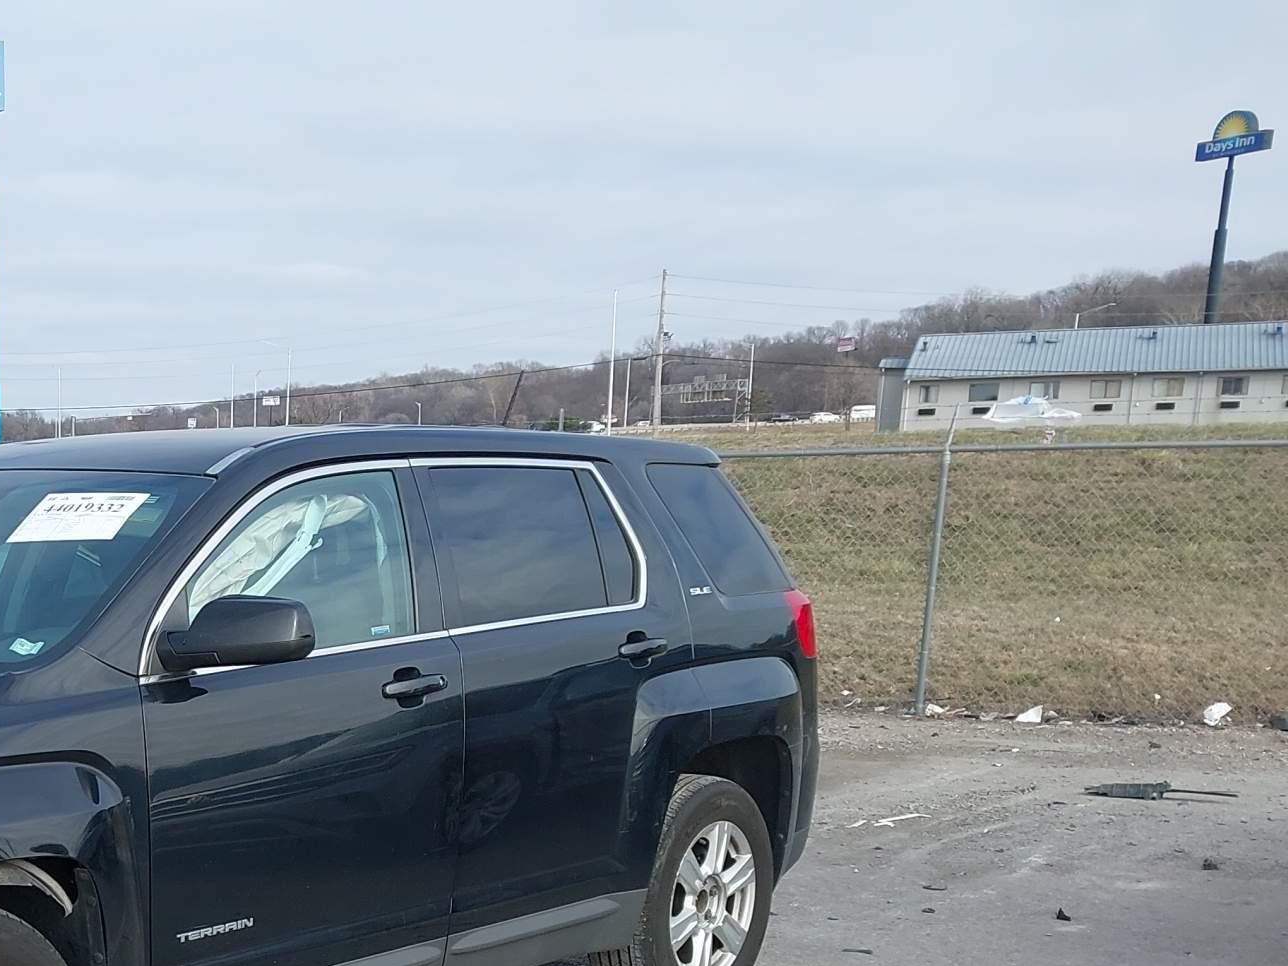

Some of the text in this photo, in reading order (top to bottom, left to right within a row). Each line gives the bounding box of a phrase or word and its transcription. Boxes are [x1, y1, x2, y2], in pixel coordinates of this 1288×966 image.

[1204, 139, 1234, 153] Days
[1235, 136, 1255, 148] Inn
[43, 502, 125, 513] 44019332
[689, 586, 713, 596] SLE
[176, 917, 254, 943] TERRAIN
